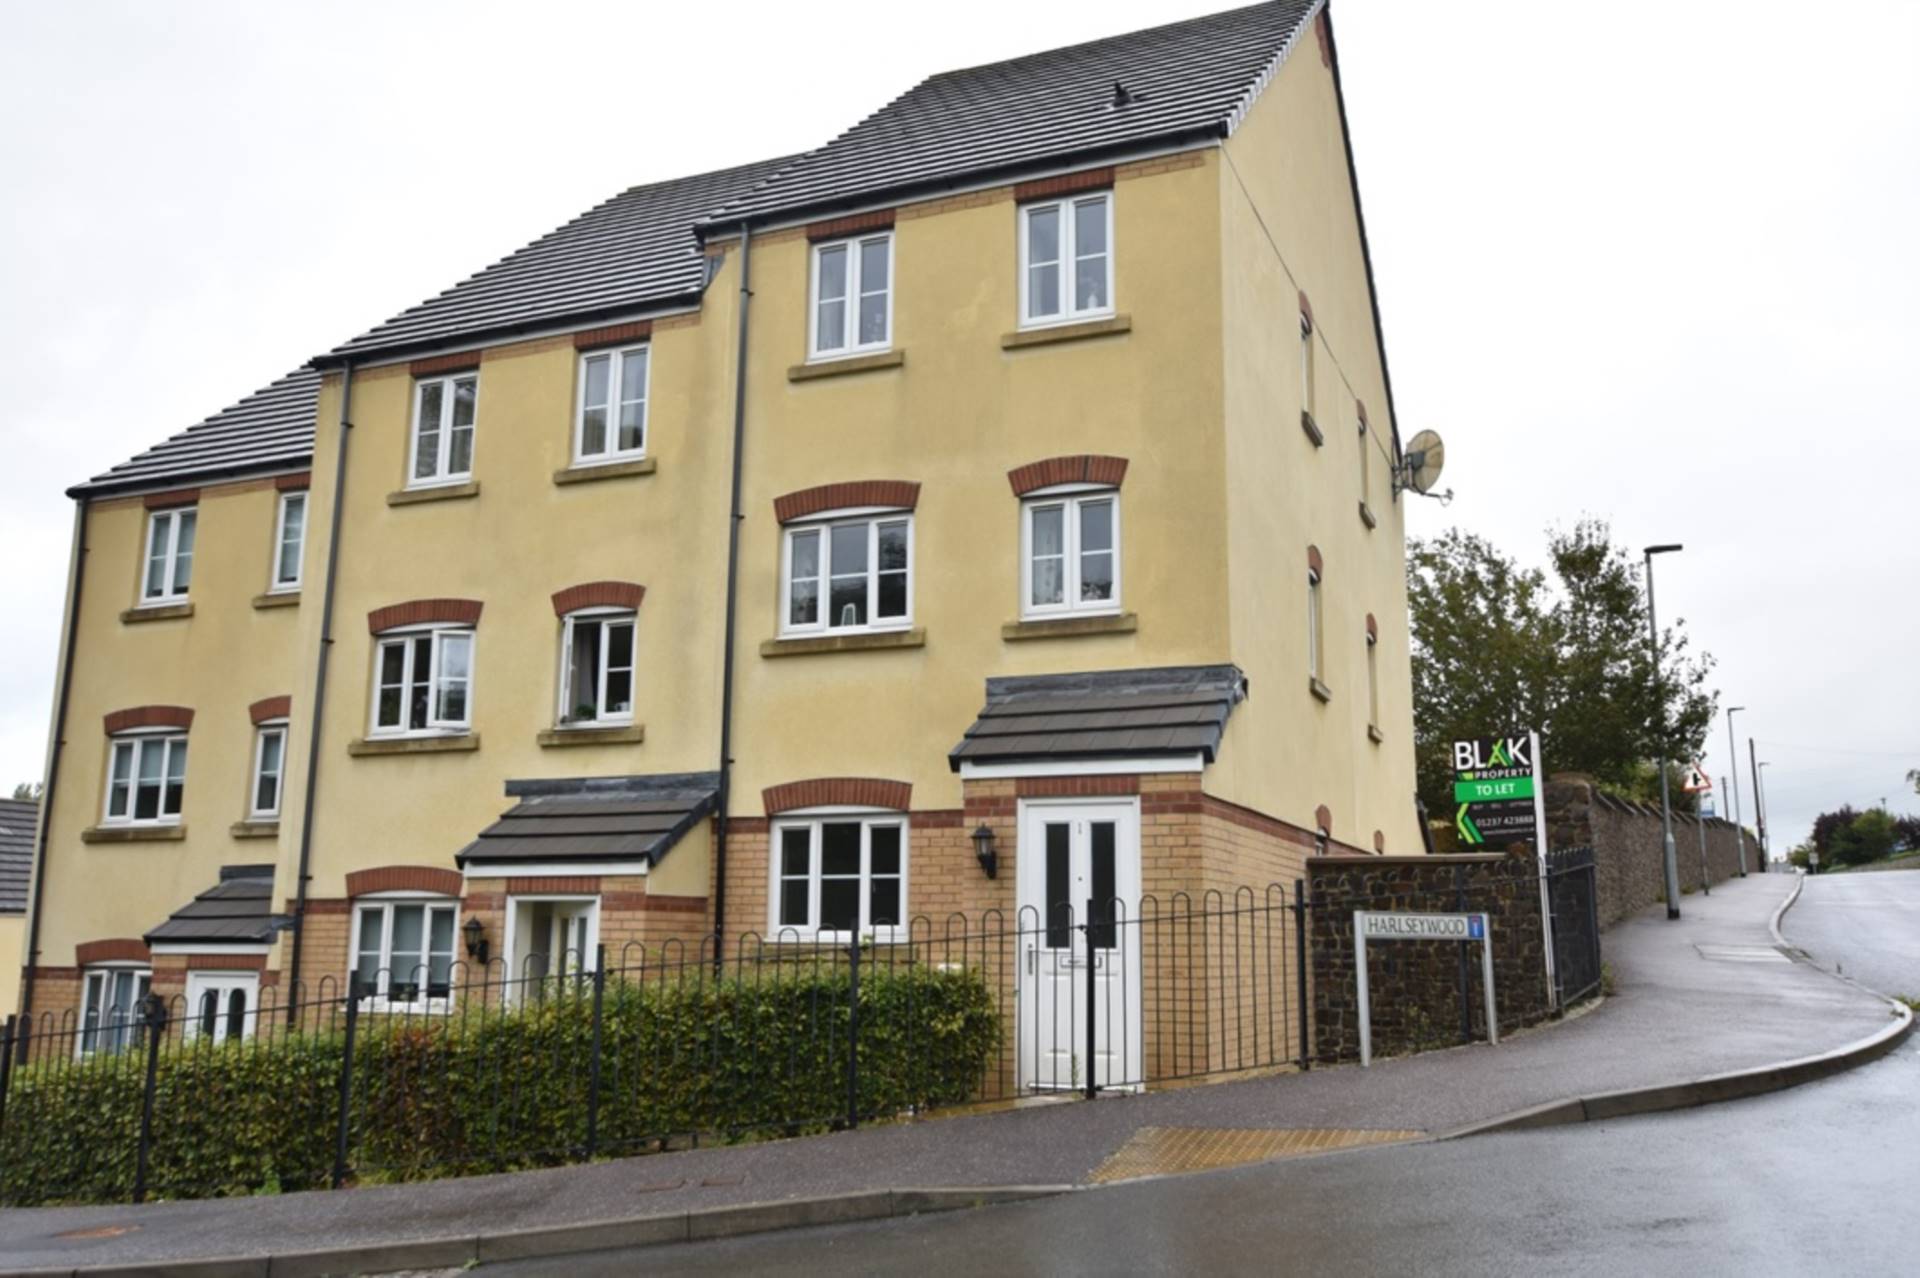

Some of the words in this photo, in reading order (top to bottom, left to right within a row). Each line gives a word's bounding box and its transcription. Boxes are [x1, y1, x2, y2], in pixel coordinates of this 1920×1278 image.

[1454, 736, 1530, 770] BLAK
[1475, 769, 1532, 779] PROPERTY
[1476, 785, 1492, 796] TO
[1494, 783, 1515, 795] LET
[1368, 917, 1465, 935] HARLSEYWOOD
